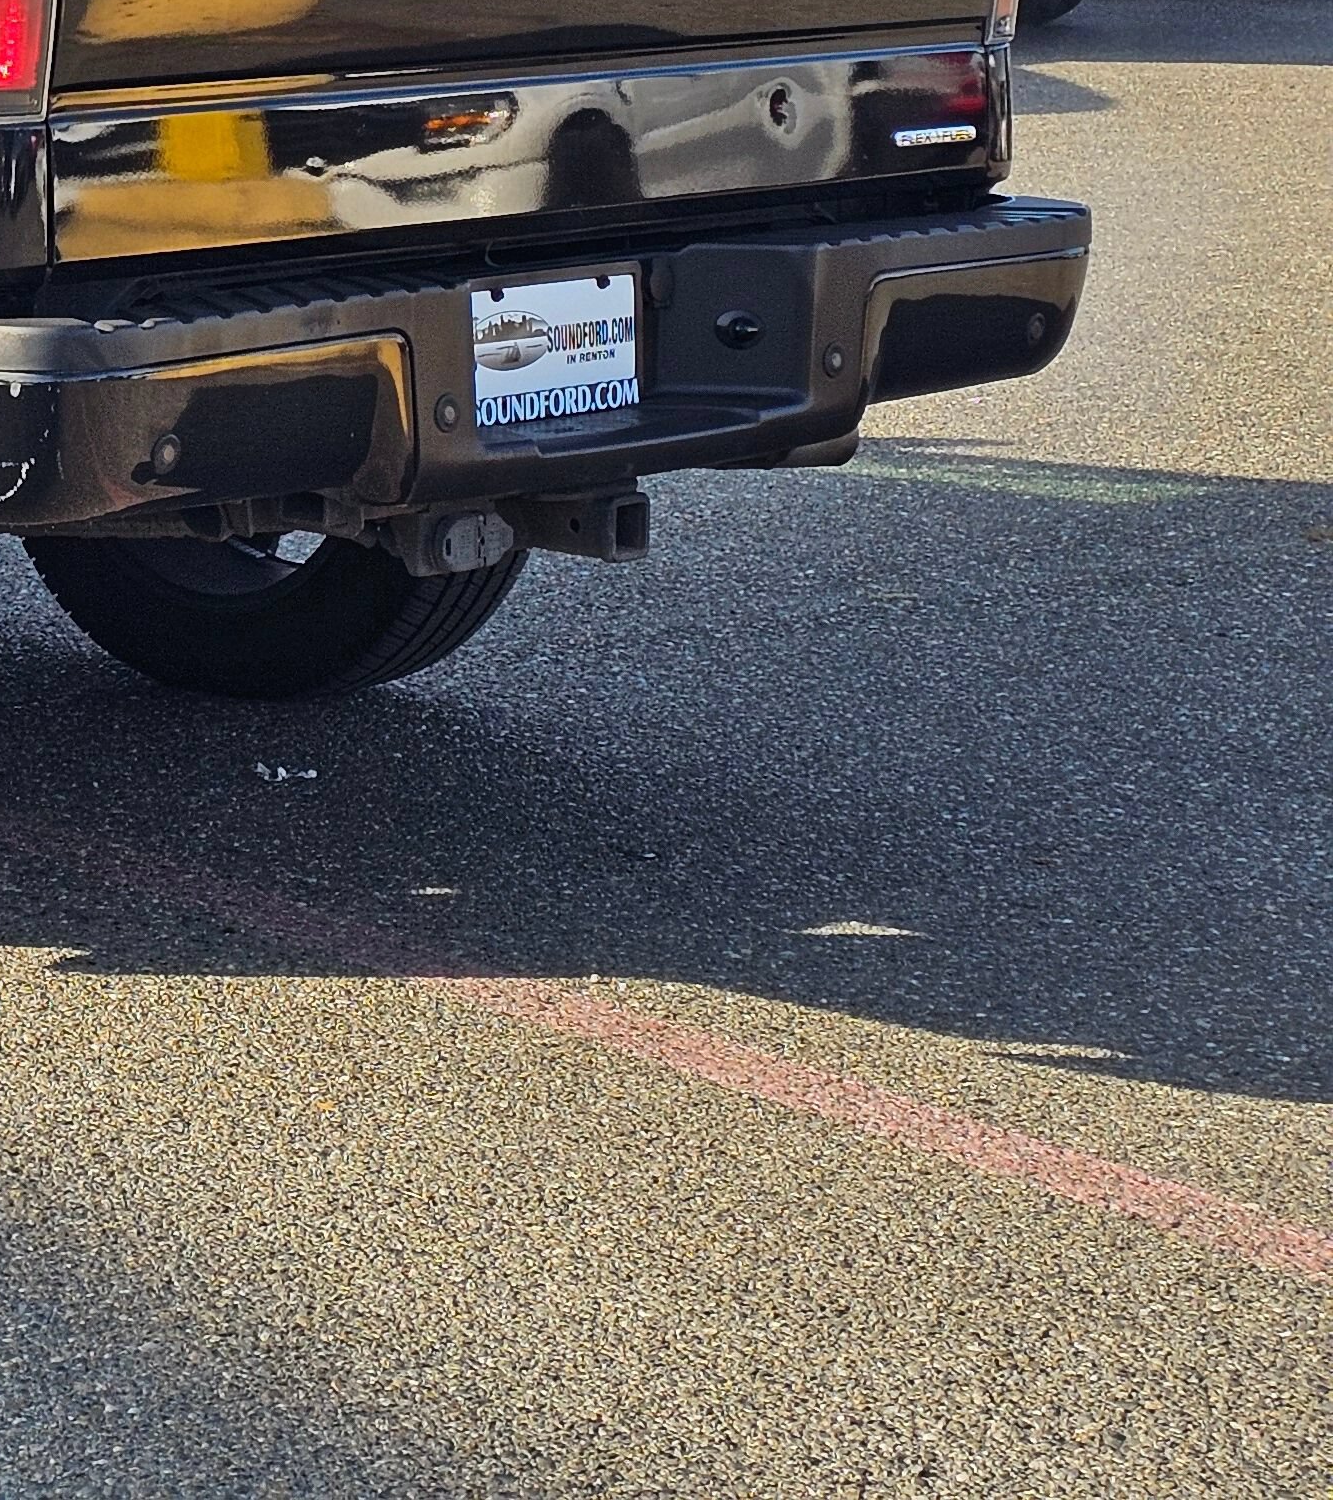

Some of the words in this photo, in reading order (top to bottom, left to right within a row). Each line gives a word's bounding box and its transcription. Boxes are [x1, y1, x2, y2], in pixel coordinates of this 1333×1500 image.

[546, 315, 634, 353] SOUNDFORD.COM
[566, 354, 576, 365] IN
[579, 349, 616, 363] RENTON
